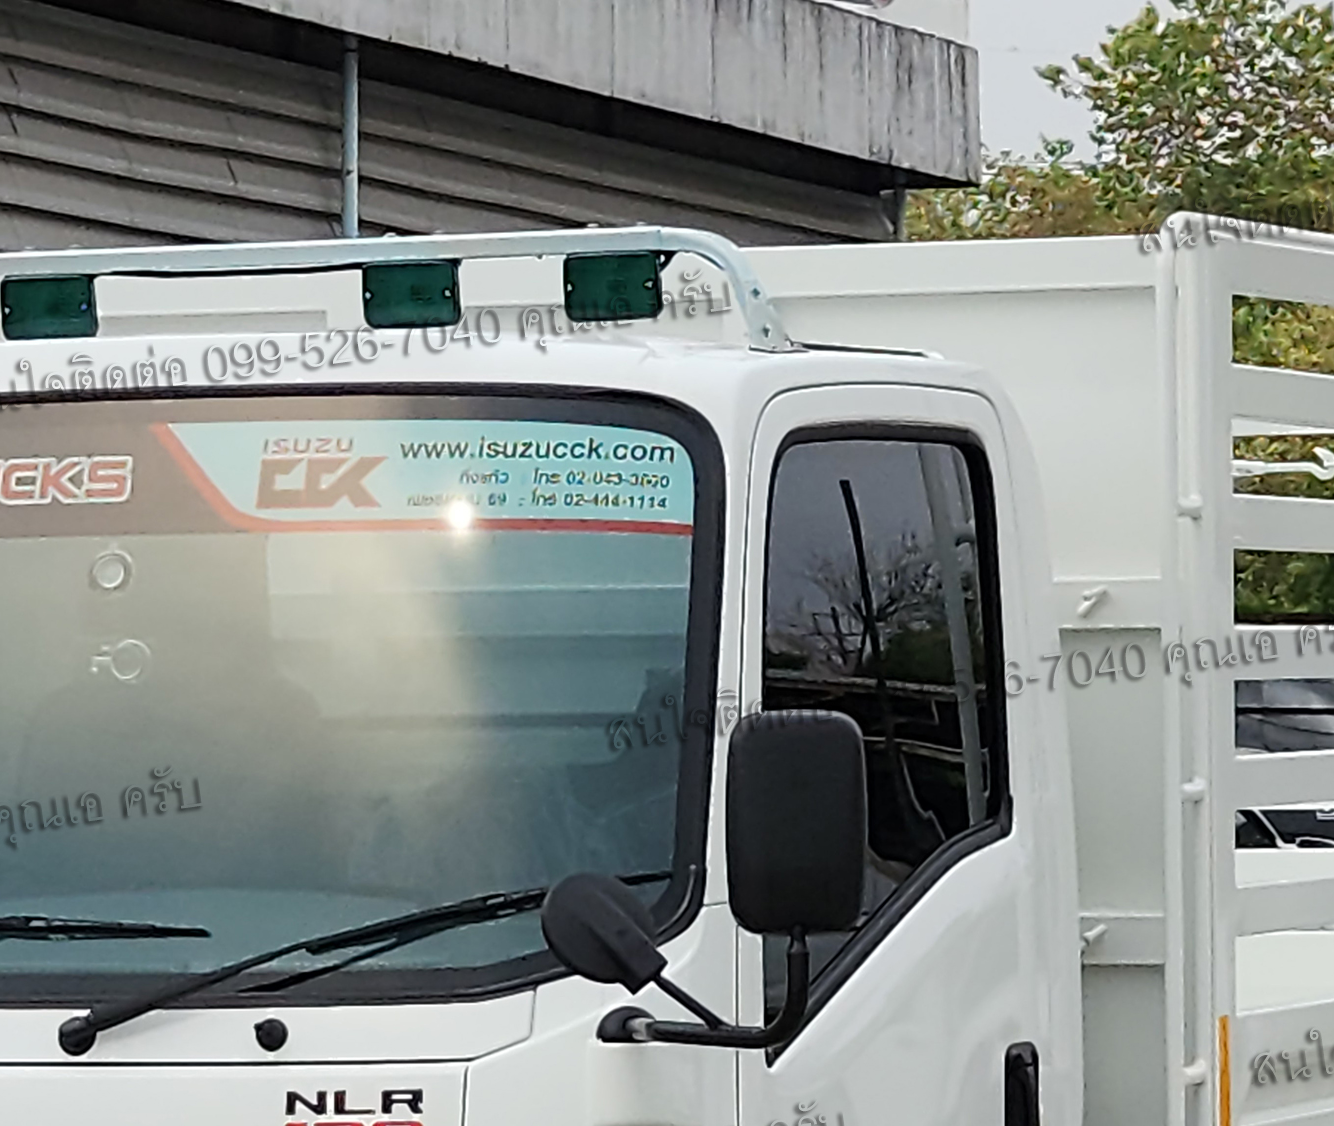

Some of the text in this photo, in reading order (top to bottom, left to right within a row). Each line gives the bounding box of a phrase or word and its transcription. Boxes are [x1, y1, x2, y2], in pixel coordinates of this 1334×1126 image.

[263, 437, 354, 455] ISUZU
[400, 435, 675, 464] www.isuzucck.com
[285, 1089, 424, 1115] NLR
